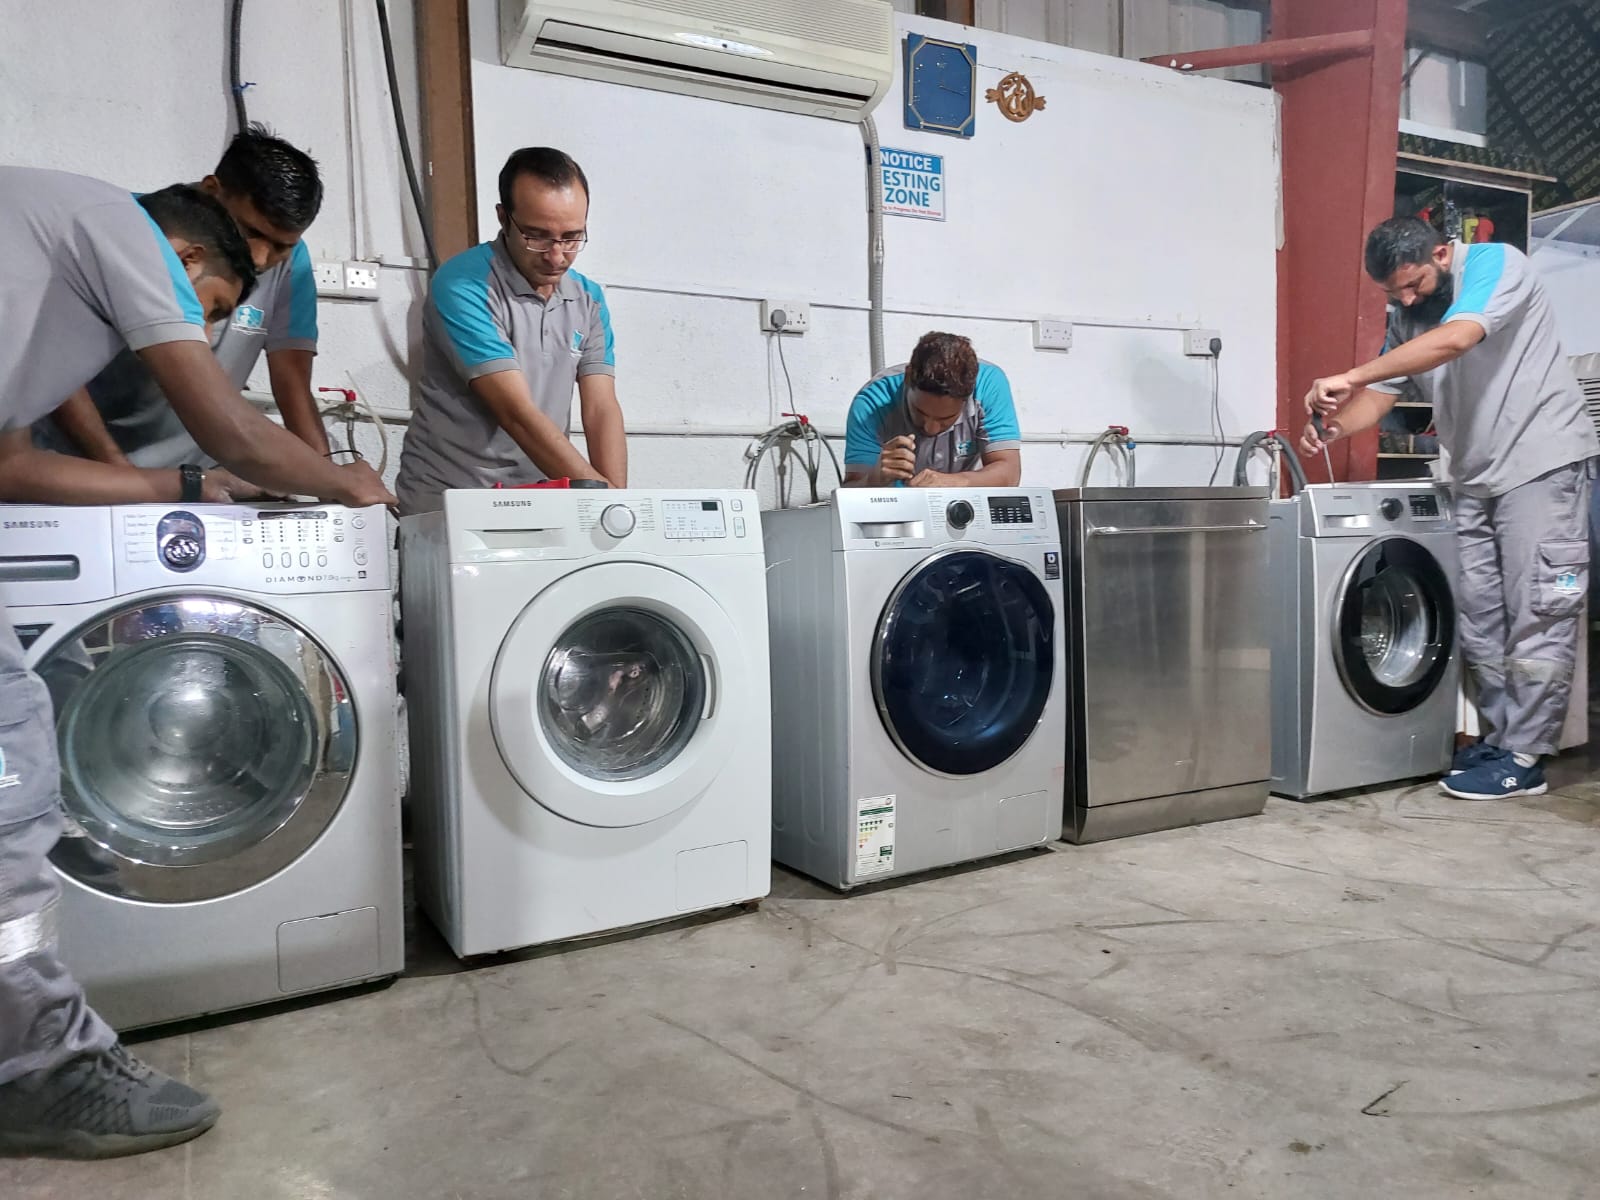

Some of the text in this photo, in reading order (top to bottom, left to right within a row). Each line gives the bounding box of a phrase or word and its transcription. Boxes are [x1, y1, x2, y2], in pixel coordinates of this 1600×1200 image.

[880, 151, 932, 171] NOTICE
[883, 170, 940, 191] ESTING
[885, 187, 930, 207] ZONE
[492, 500, 532, 508] SAMSUNG
[2, 520, 60, 529] SAMSUNG
[265, 574, 323, 584] DIAMOND
